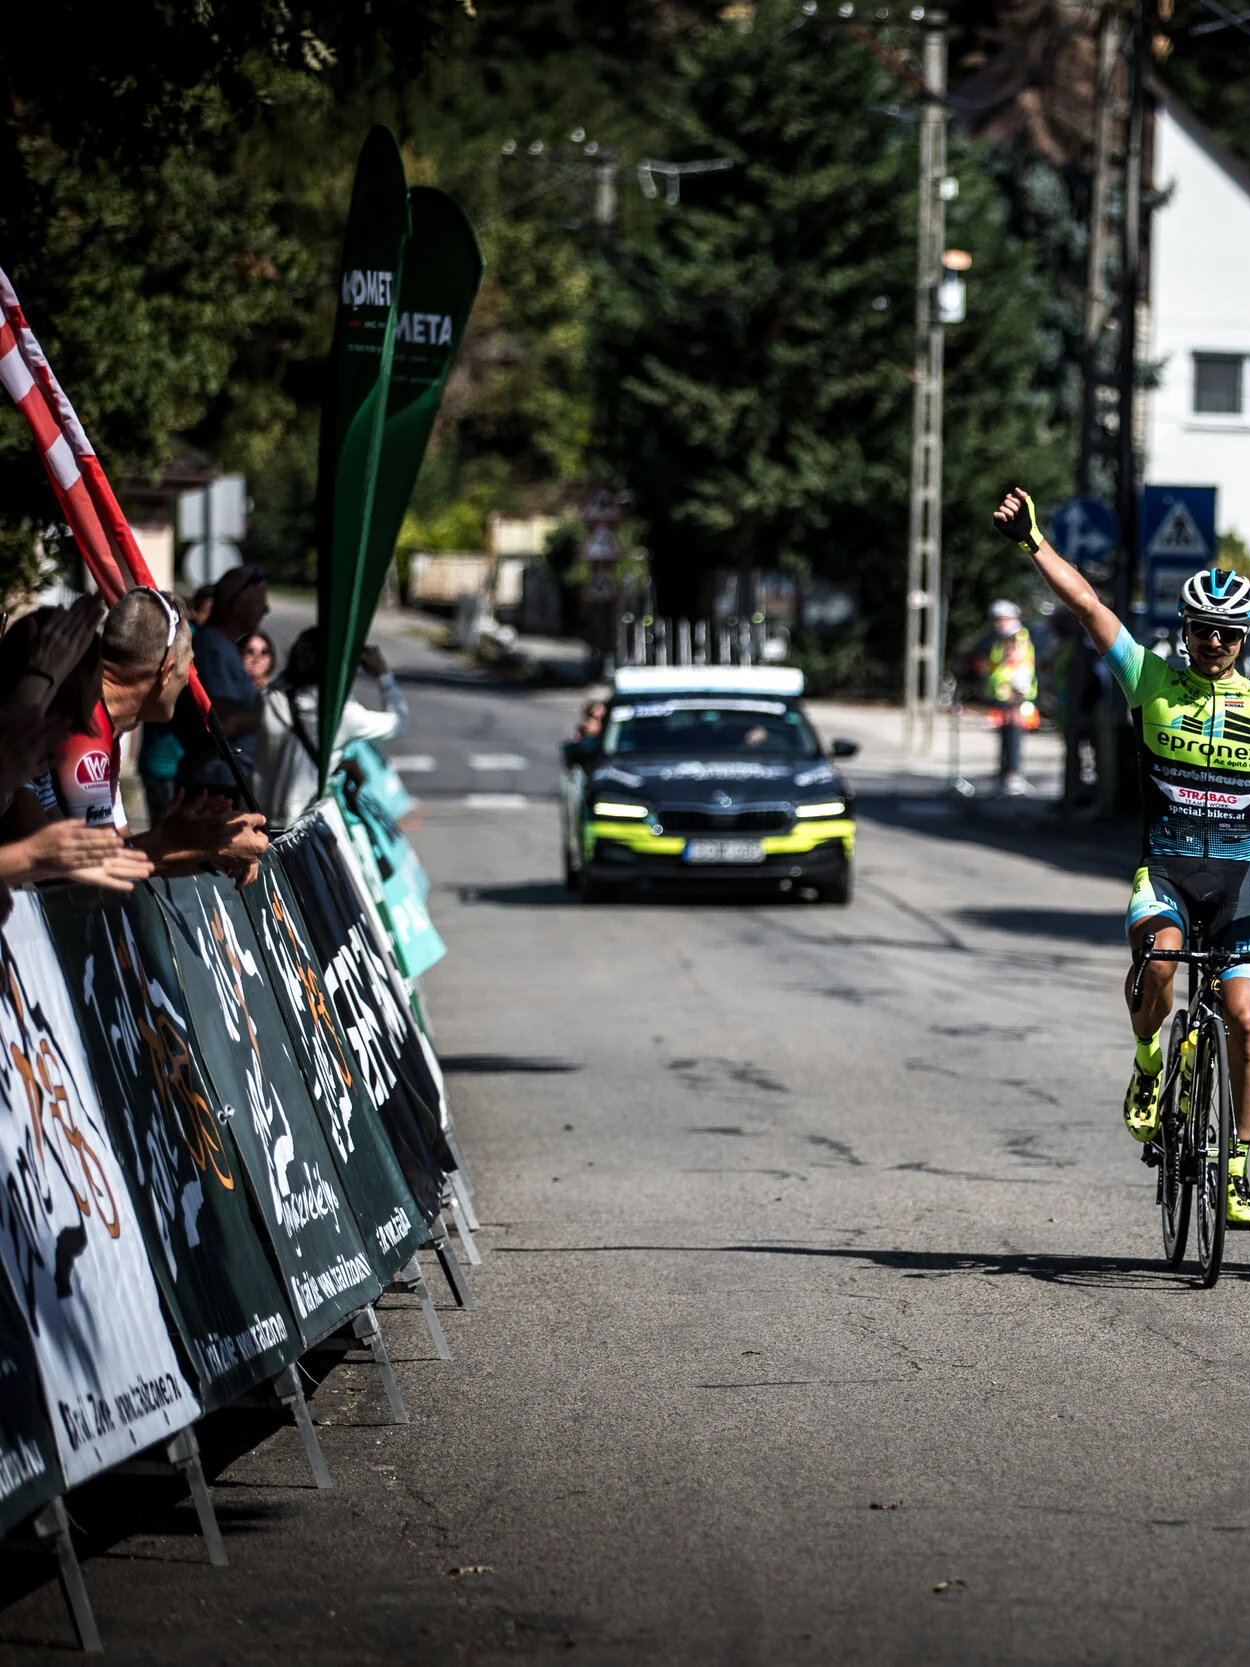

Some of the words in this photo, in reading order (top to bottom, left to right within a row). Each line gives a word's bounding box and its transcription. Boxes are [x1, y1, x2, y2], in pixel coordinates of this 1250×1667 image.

[341, 268, 396, 311] KOMET
[396, 310, 453, 347] META
[1179, 788, 1238, 804] STRABAG
